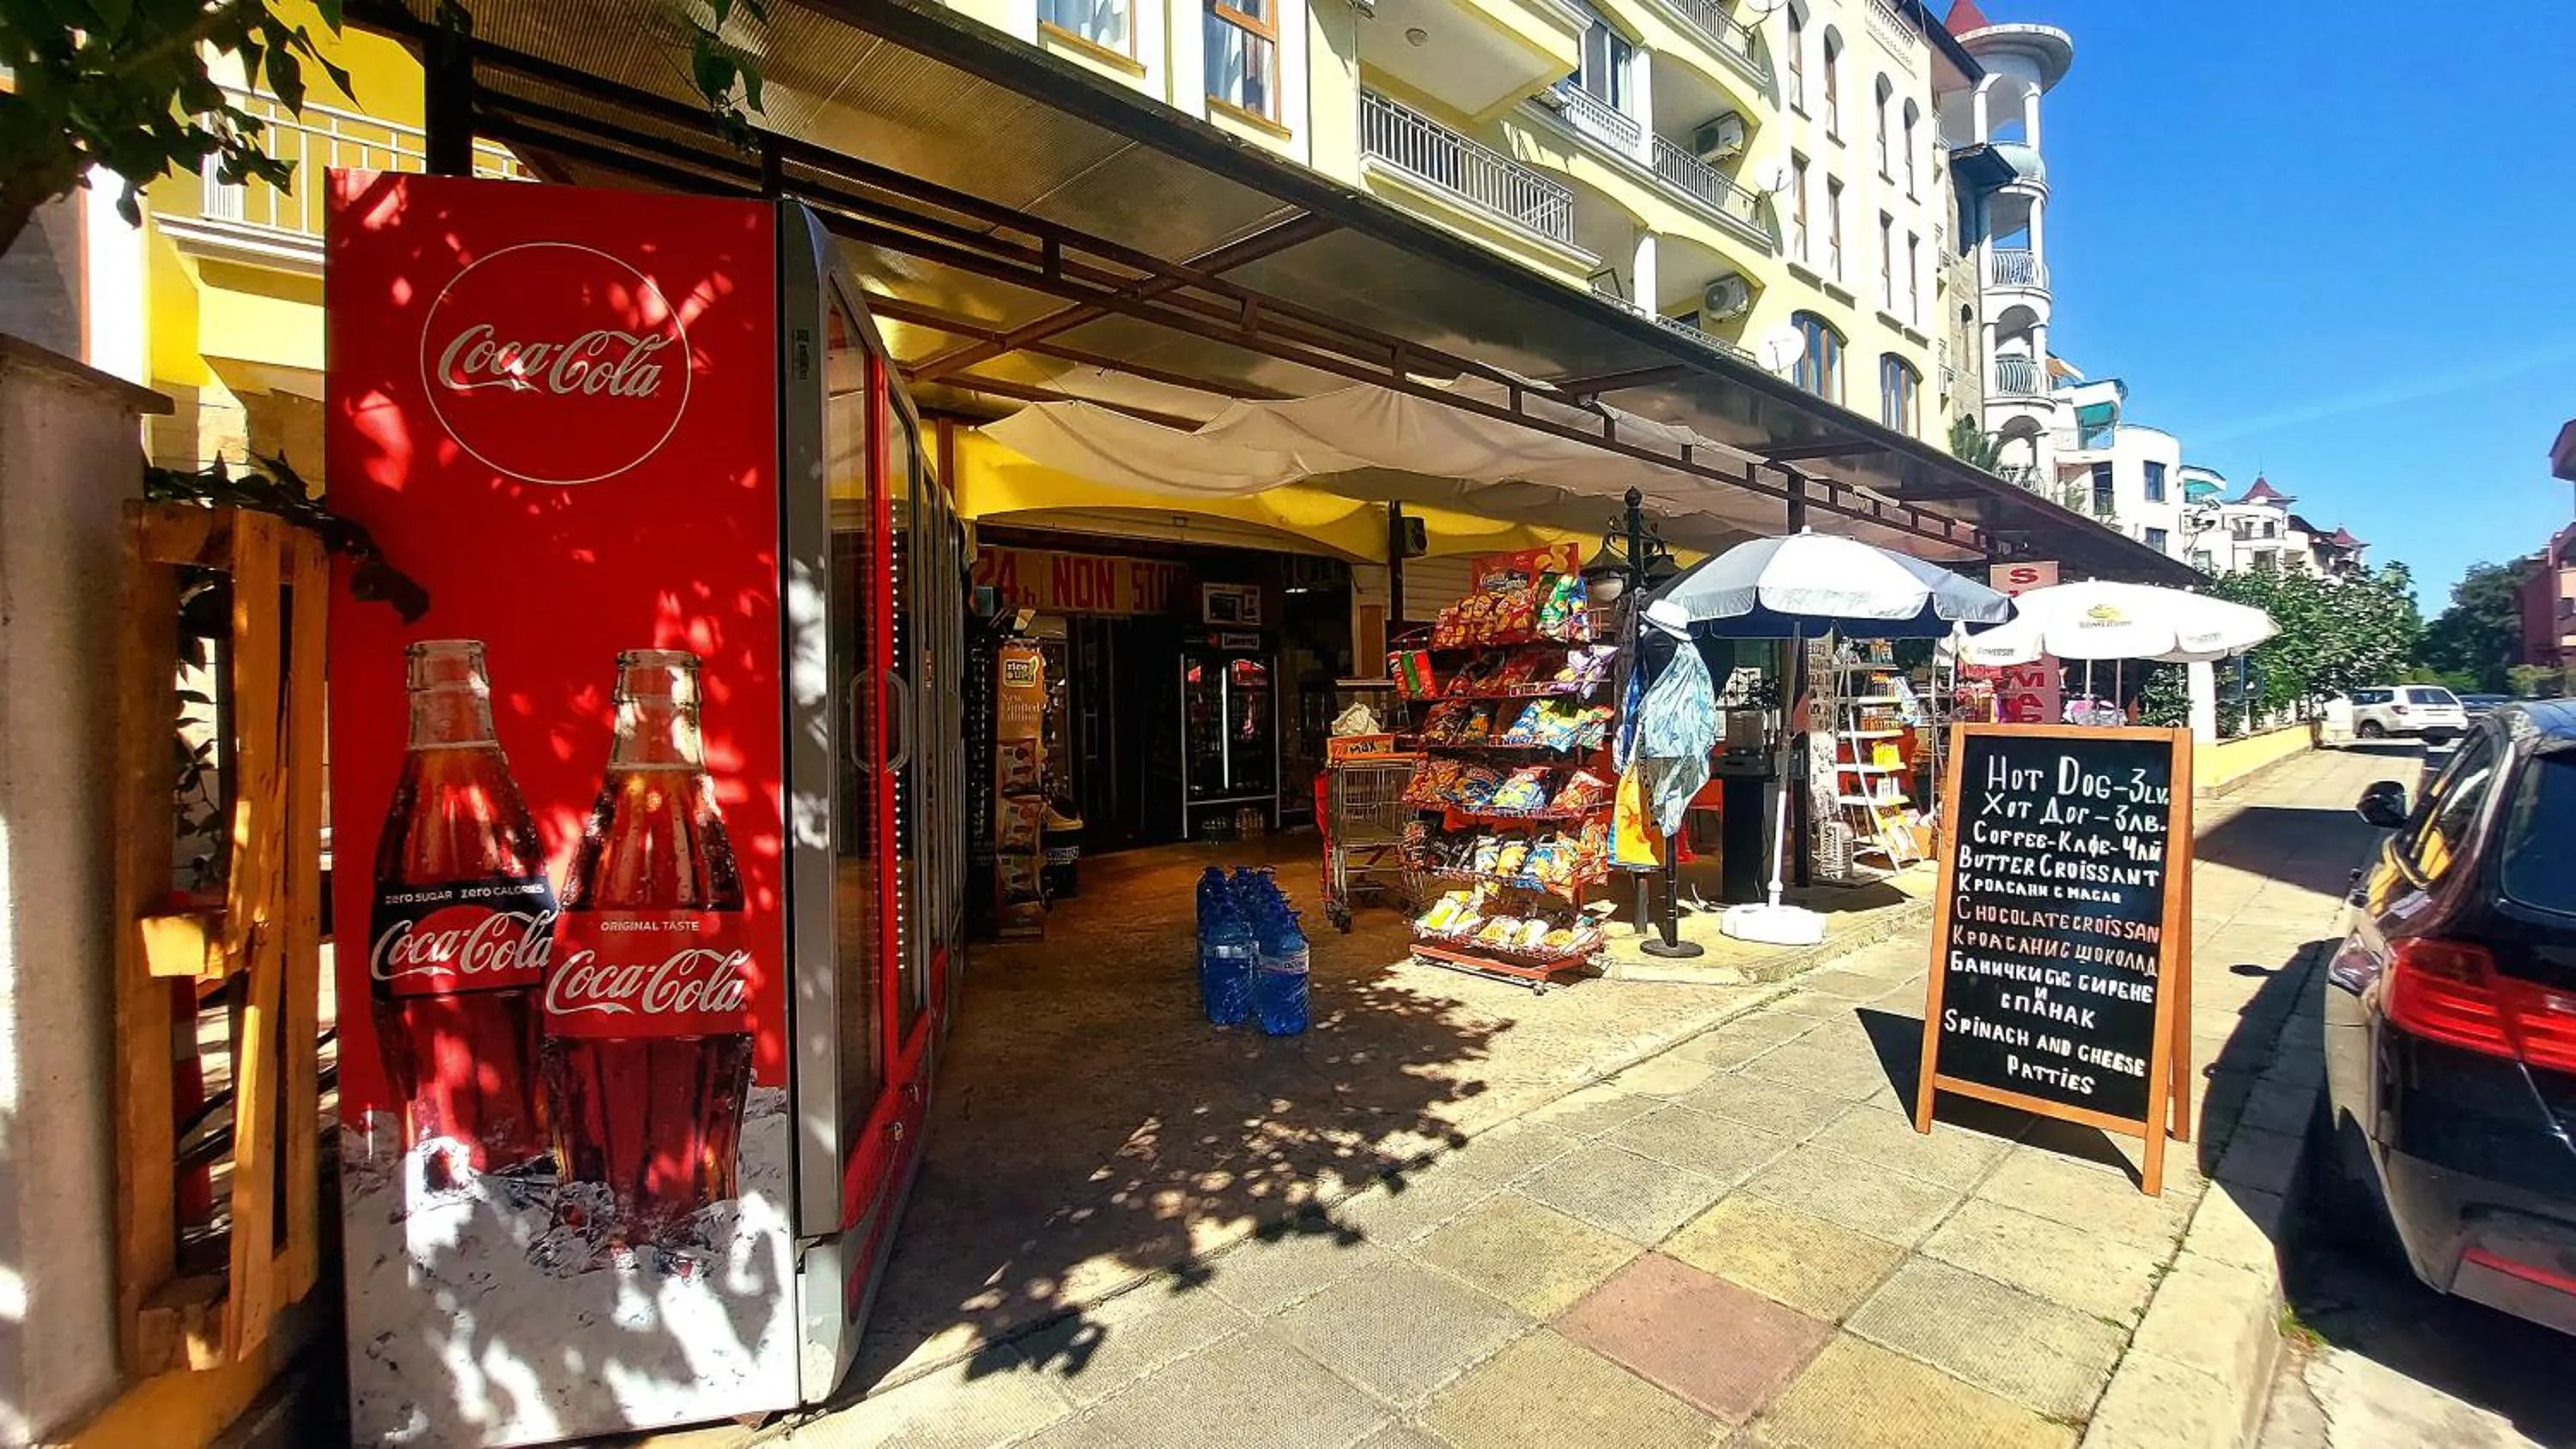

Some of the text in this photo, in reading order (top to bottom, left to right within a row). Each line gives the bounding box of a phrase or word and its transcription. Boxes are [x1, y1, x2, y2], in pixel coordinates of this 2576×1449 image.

[437, 324, 676, 396] Coca-Cola
[1052, 555, 1115, 609] NON
[415, 890, 453, 903] SUGAR
[600, 920, 700, 932] ORIGINAL TASTE
[370, 909, 559, 980] Coca-Cola
[545, 949, 750, 1015] Coca-Cola
